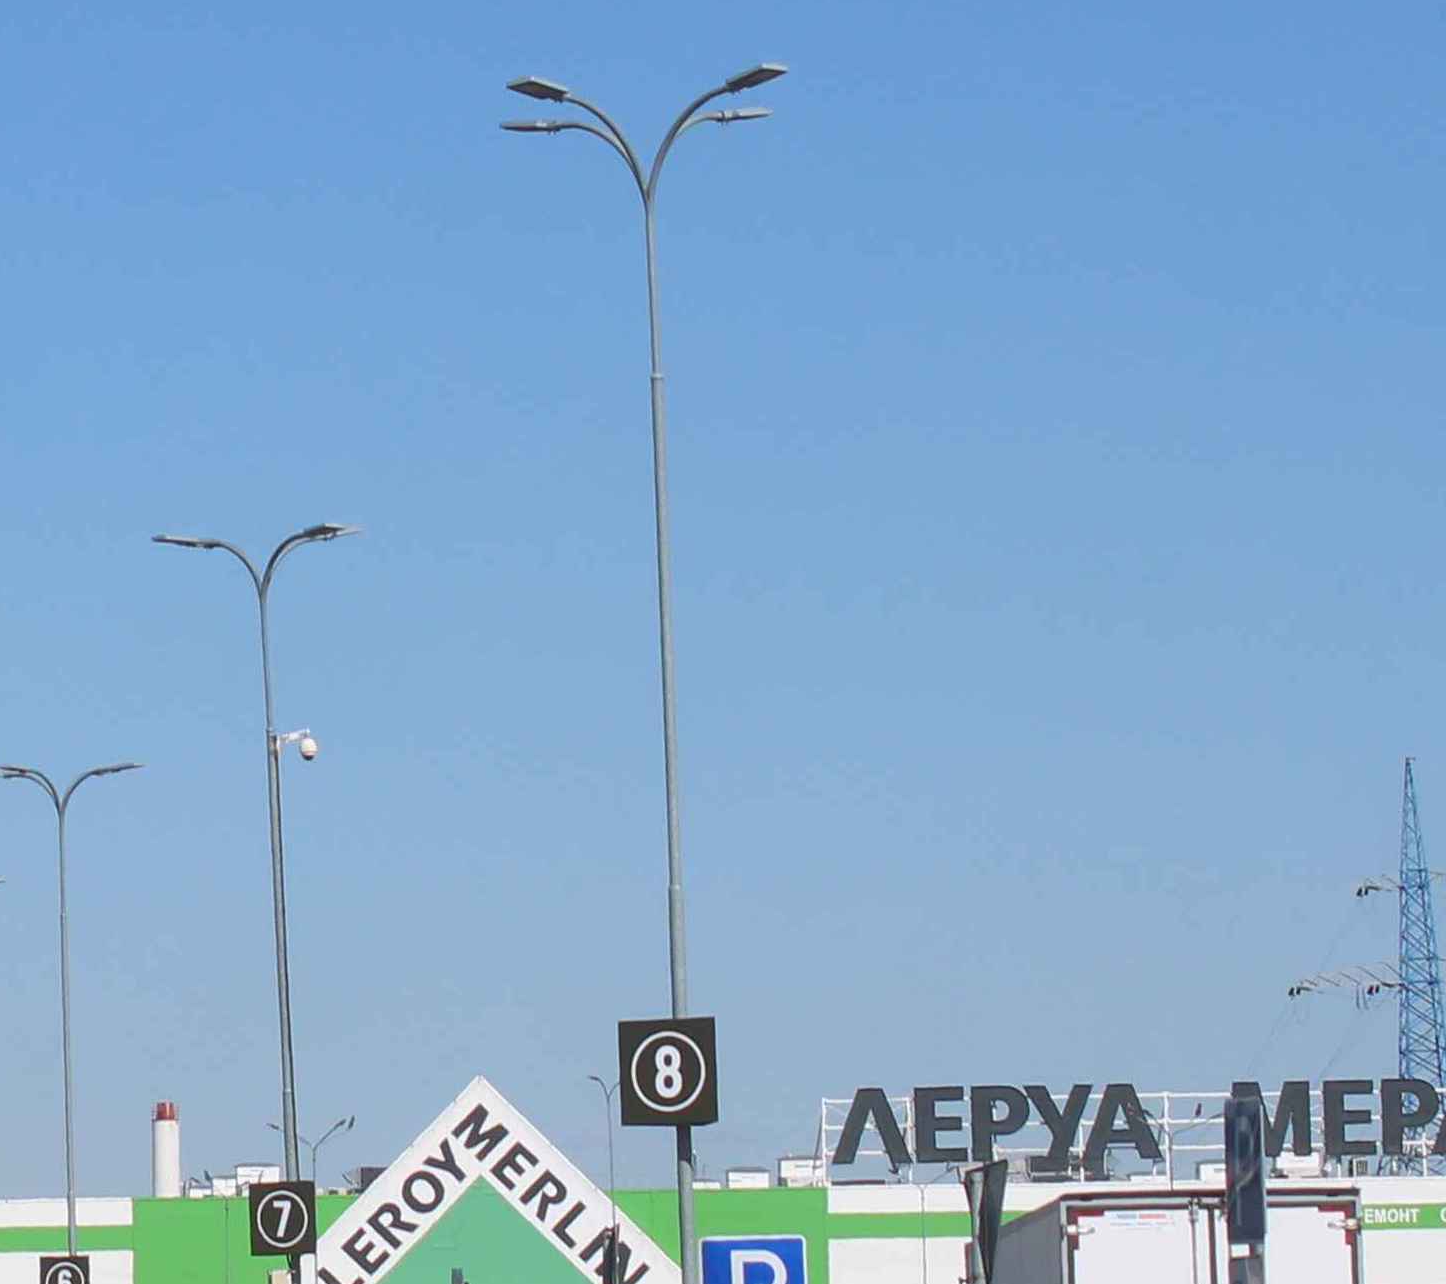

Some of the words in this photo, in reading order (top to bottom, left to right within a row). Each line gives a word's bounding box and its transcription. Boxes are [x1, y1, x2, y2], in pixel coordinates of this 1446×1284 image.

[653, 1045, 685, 1100] 8
[272, 1200, 292, 1239] 7
[1363, 1207, 1420, 1224] ЕМОНТ
